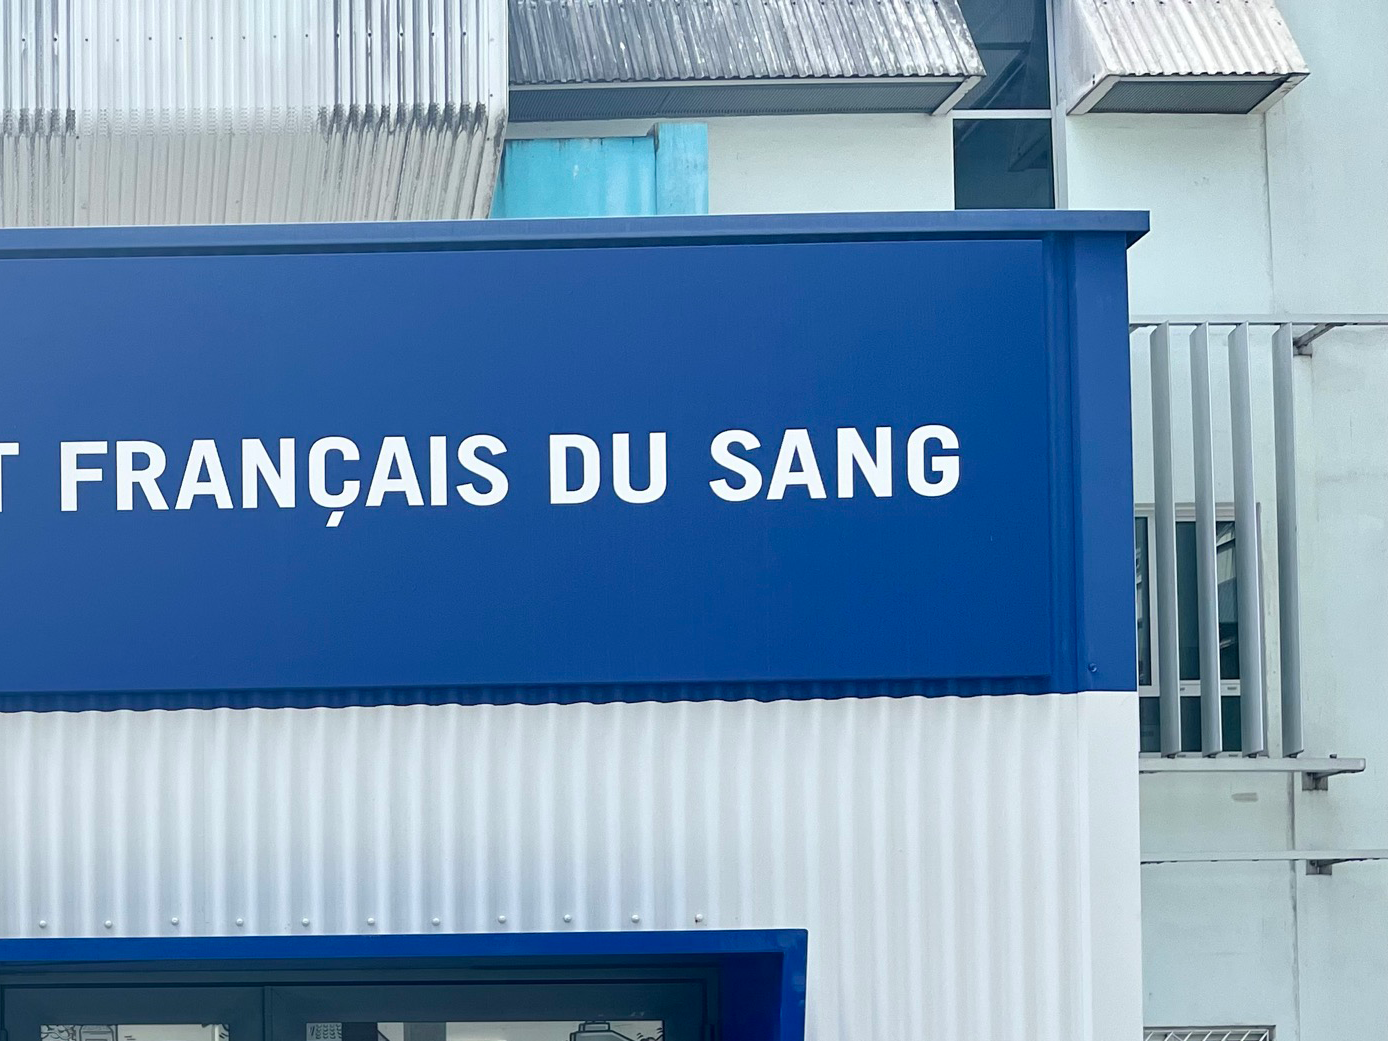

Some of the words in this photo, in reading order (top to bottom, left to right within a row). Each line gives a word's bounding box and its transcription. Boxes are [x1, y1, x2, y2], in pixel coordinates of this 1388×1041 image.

[58, 434, 511, 528] FRANÇAIS
[548, 431, 669, 506] DU
[708, 423, 962, 503] SANG
